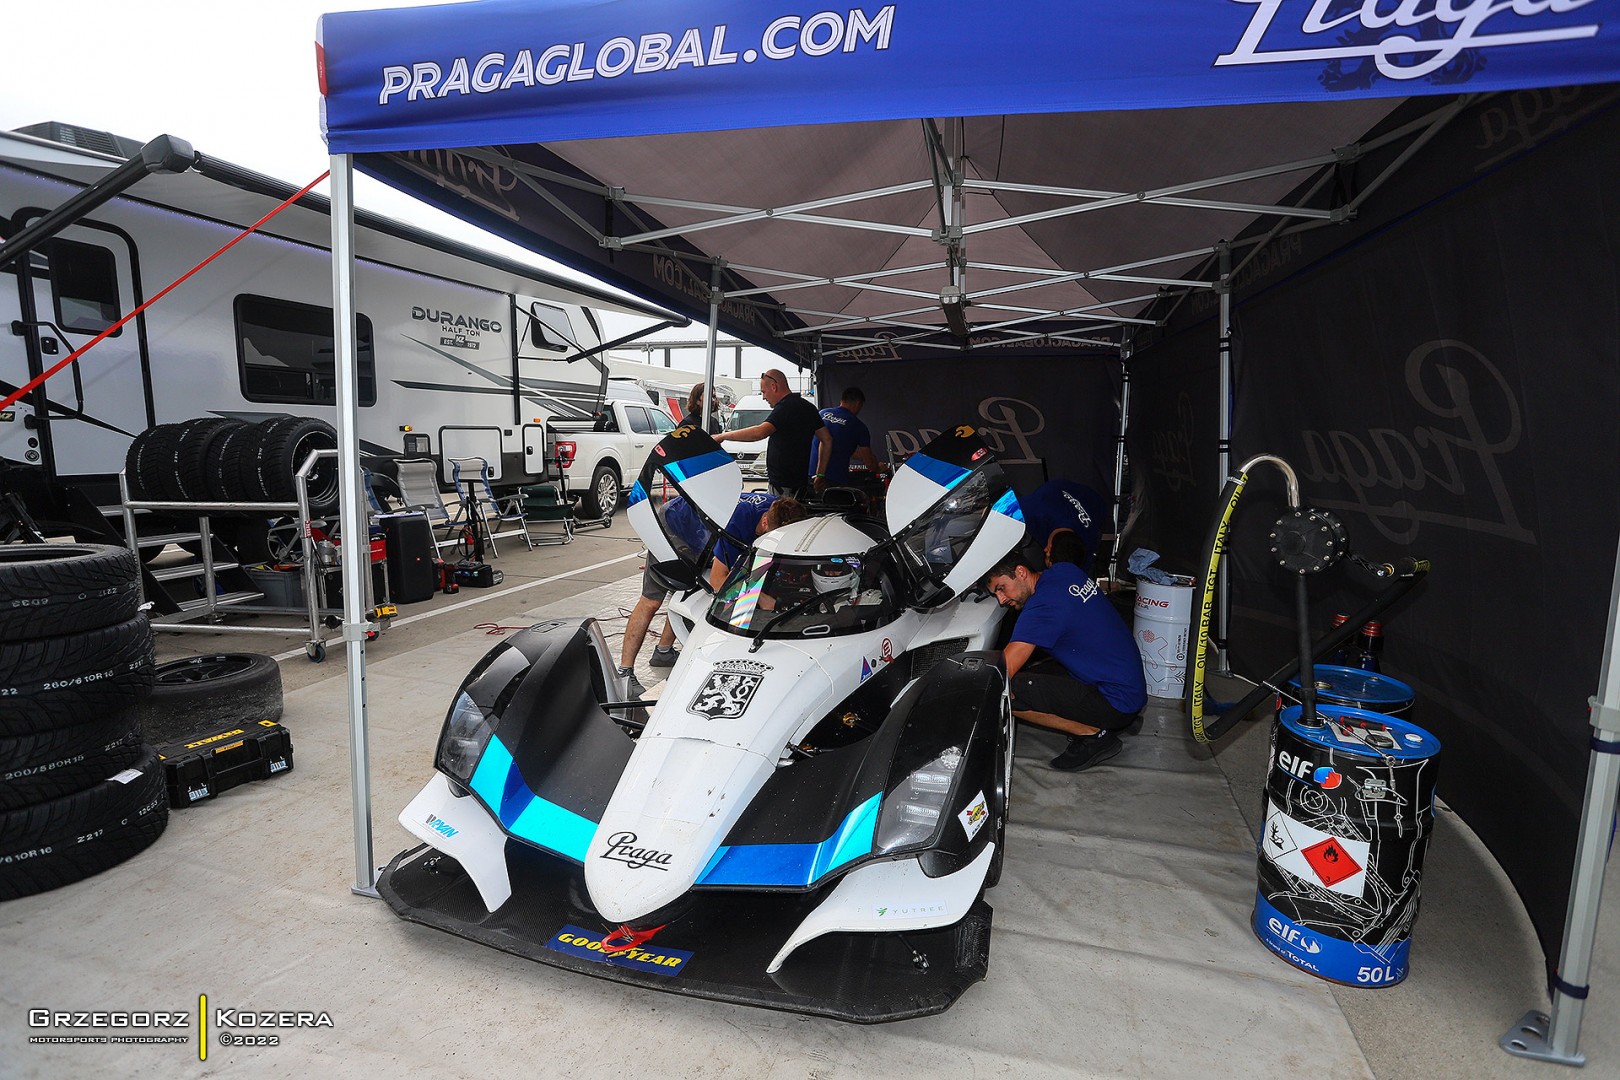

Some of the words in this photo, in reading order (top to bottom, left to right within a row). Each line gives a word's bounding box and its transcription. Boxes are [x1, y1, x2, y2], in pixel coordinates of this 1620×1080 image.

[378, 4, 896, 105] PRAGAGLOBAL.COM
[411, 306, 502, 333] DURANGO
[441, 325, 463, 334] HALF
[466, 329, 481, 337] TON
[1214, 520, 1229, 555] ITALY
[1206, 569, 1217, 594] TGT
[1202, 601, 1213, 627] BAR
[1194, 681, 1204, 707] ITALY
[1278, 750, 1314, 780] elf
[77, 829, 104, 844] Z217
[600, 831, 672, 871] Praga
[892, 904, 945, 915] YUTREE
[1268, 917, 1301, 943] elf
[1287, 951, 1320, 971] TOTAL
